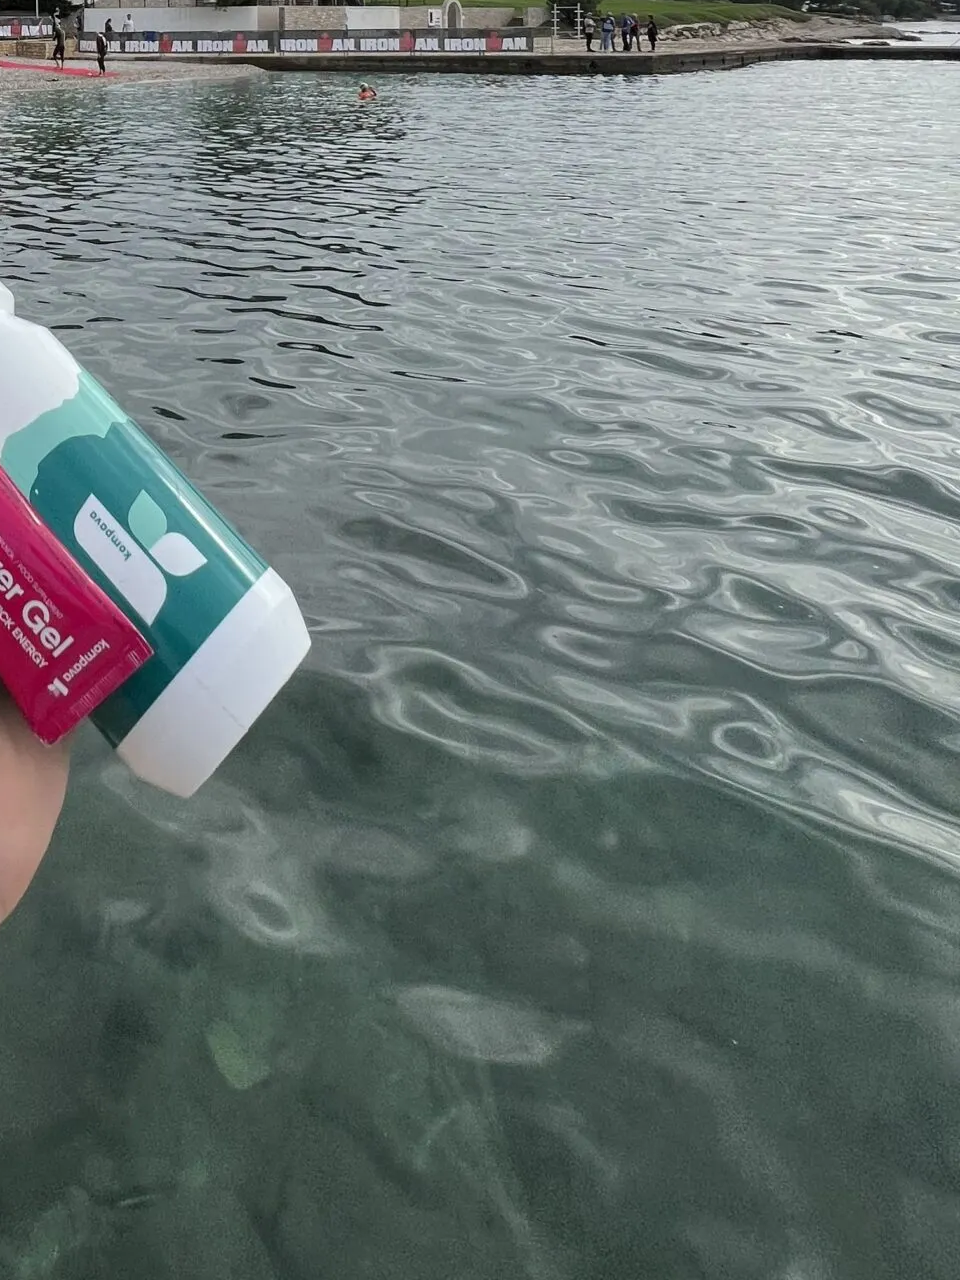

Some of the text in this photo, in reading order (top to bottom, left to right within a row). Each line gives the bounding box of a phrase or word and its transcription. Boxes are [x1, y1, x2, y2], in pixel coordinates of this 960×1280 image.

[125, 33, 194, 53] IRONMAN
[197, 32, 270, 54] IRONMAN
[280, 32, 355, 52] IRONMAN
[360, 32, 439, 52] IRONMAN
[444, 31, 527, 52] IRONMAN
[90, 511, 132, 561] kompava
[12, 627, 48, 668] ENERGY
[22, 599, 74, 658] Gel
[62, 638, 110, 682] kompava
